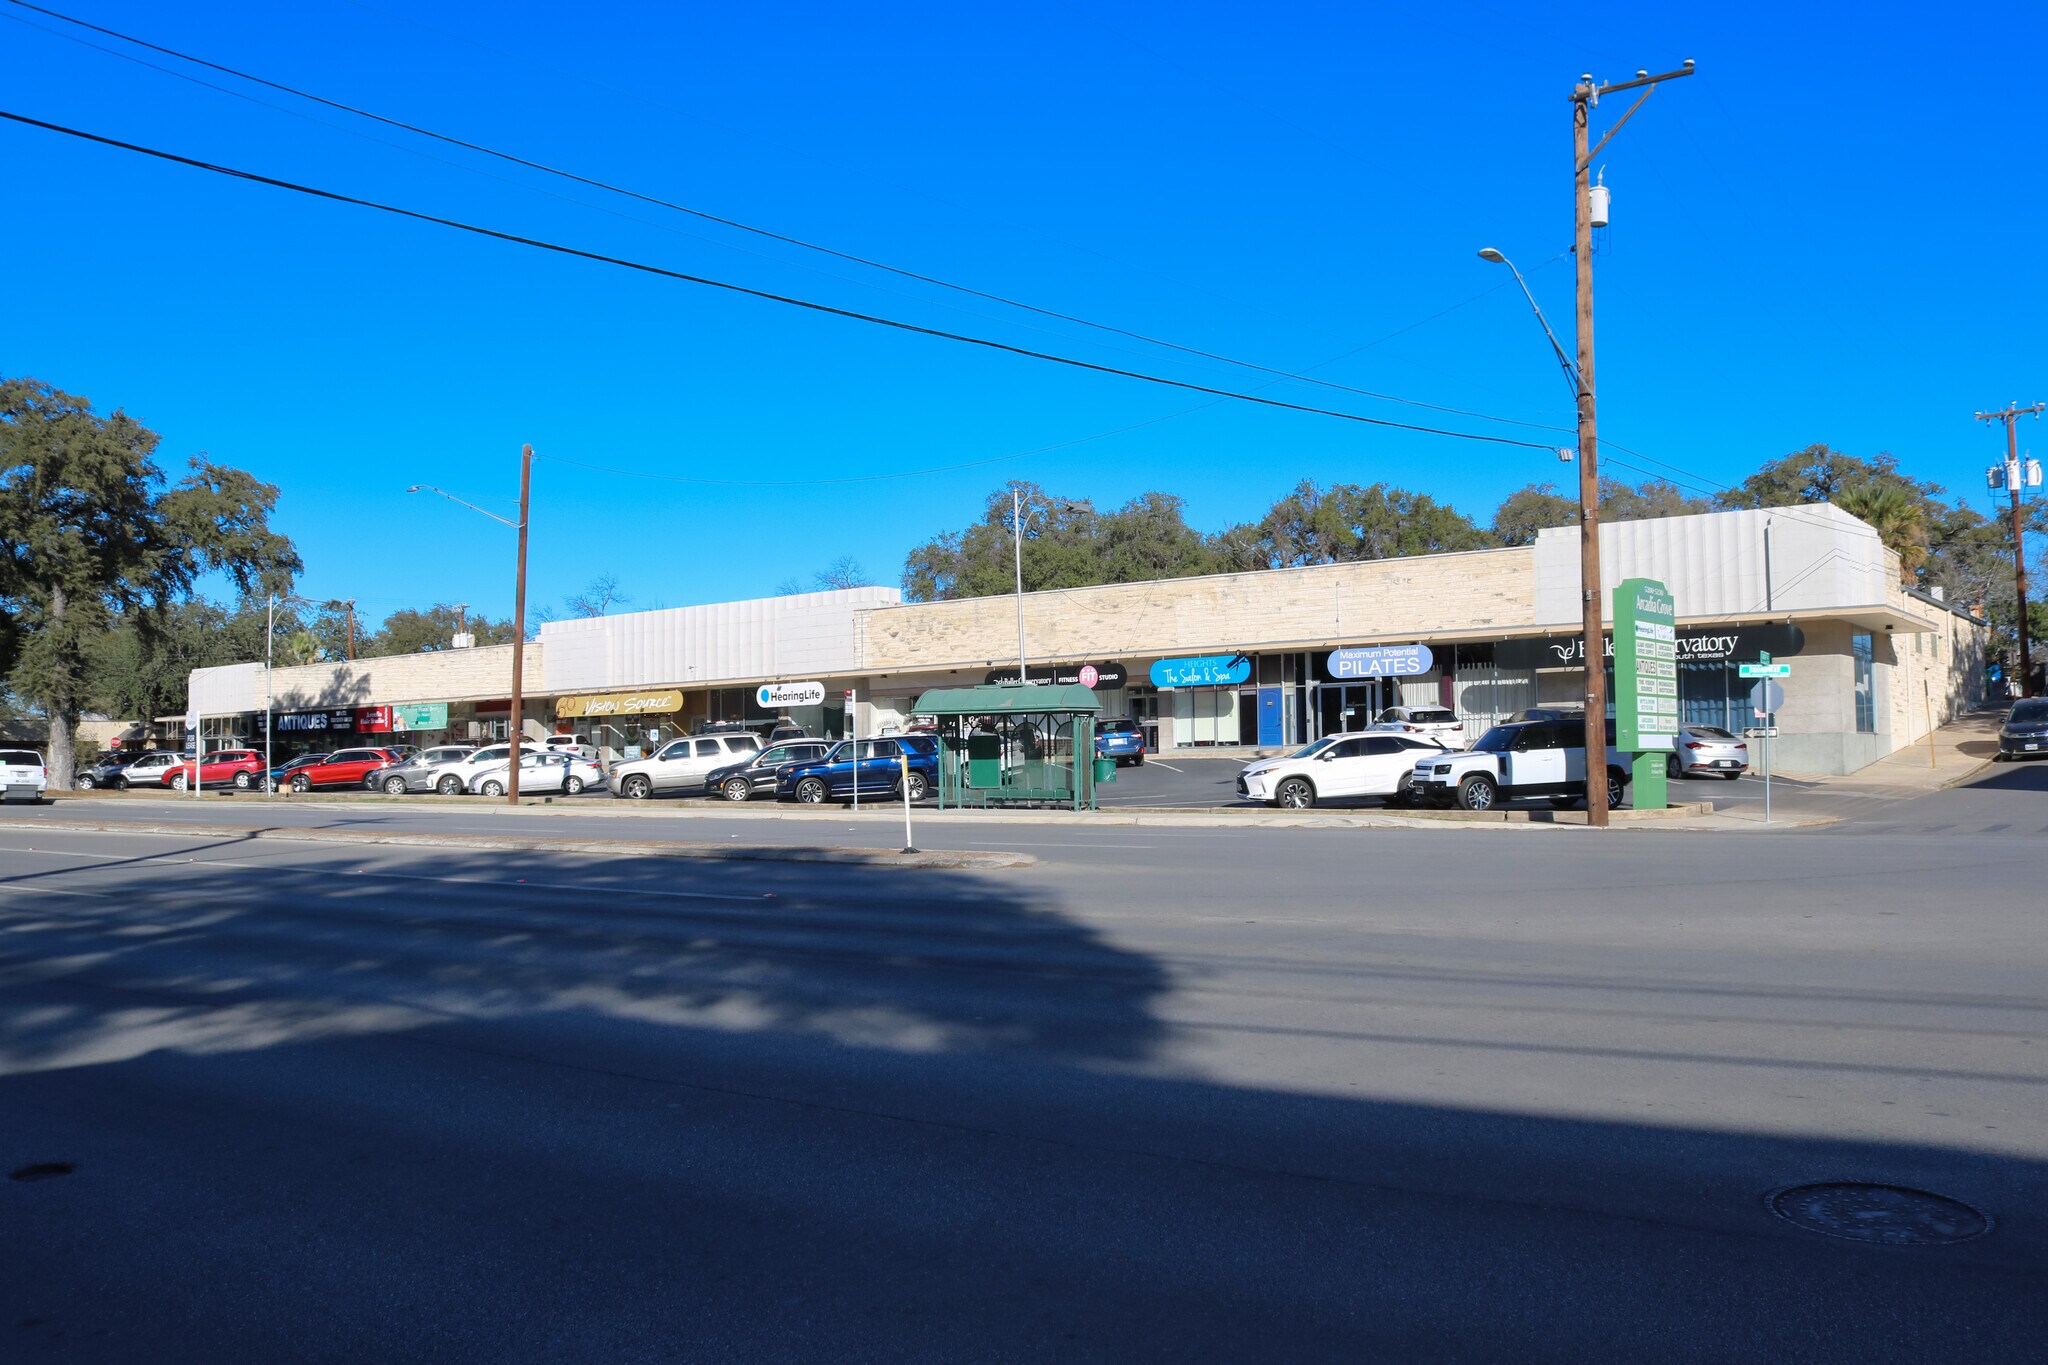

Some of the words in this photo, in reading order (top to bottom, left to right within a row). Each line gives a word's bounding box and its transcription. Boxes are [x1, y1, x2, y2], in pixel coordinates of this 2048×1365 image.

[1636, 594, 1657, 613] Arcadia
[1657, 598, 1673, 616] Grove
[1340, 650, 1382, 660] Maximum
[1383, 647, 1419, 657] Potential
[1675, 635, 1739, 656] rvatory
[1184, 658, 1218, 668] HEIGHTS
[1339, 657, 1420, 676] PILATES
[1098, 673, 1118, 681] STUDIO
[1162, 668, 1178, 684] The
[1179, 667, 1202, 684] Salon
[1204, 667, 1210, 682] &
[1212, 667, 1231, 684] Spa
[770, 690, 820, 703] HearingLife
[278, 713, 327, 731] ANTIQUES
